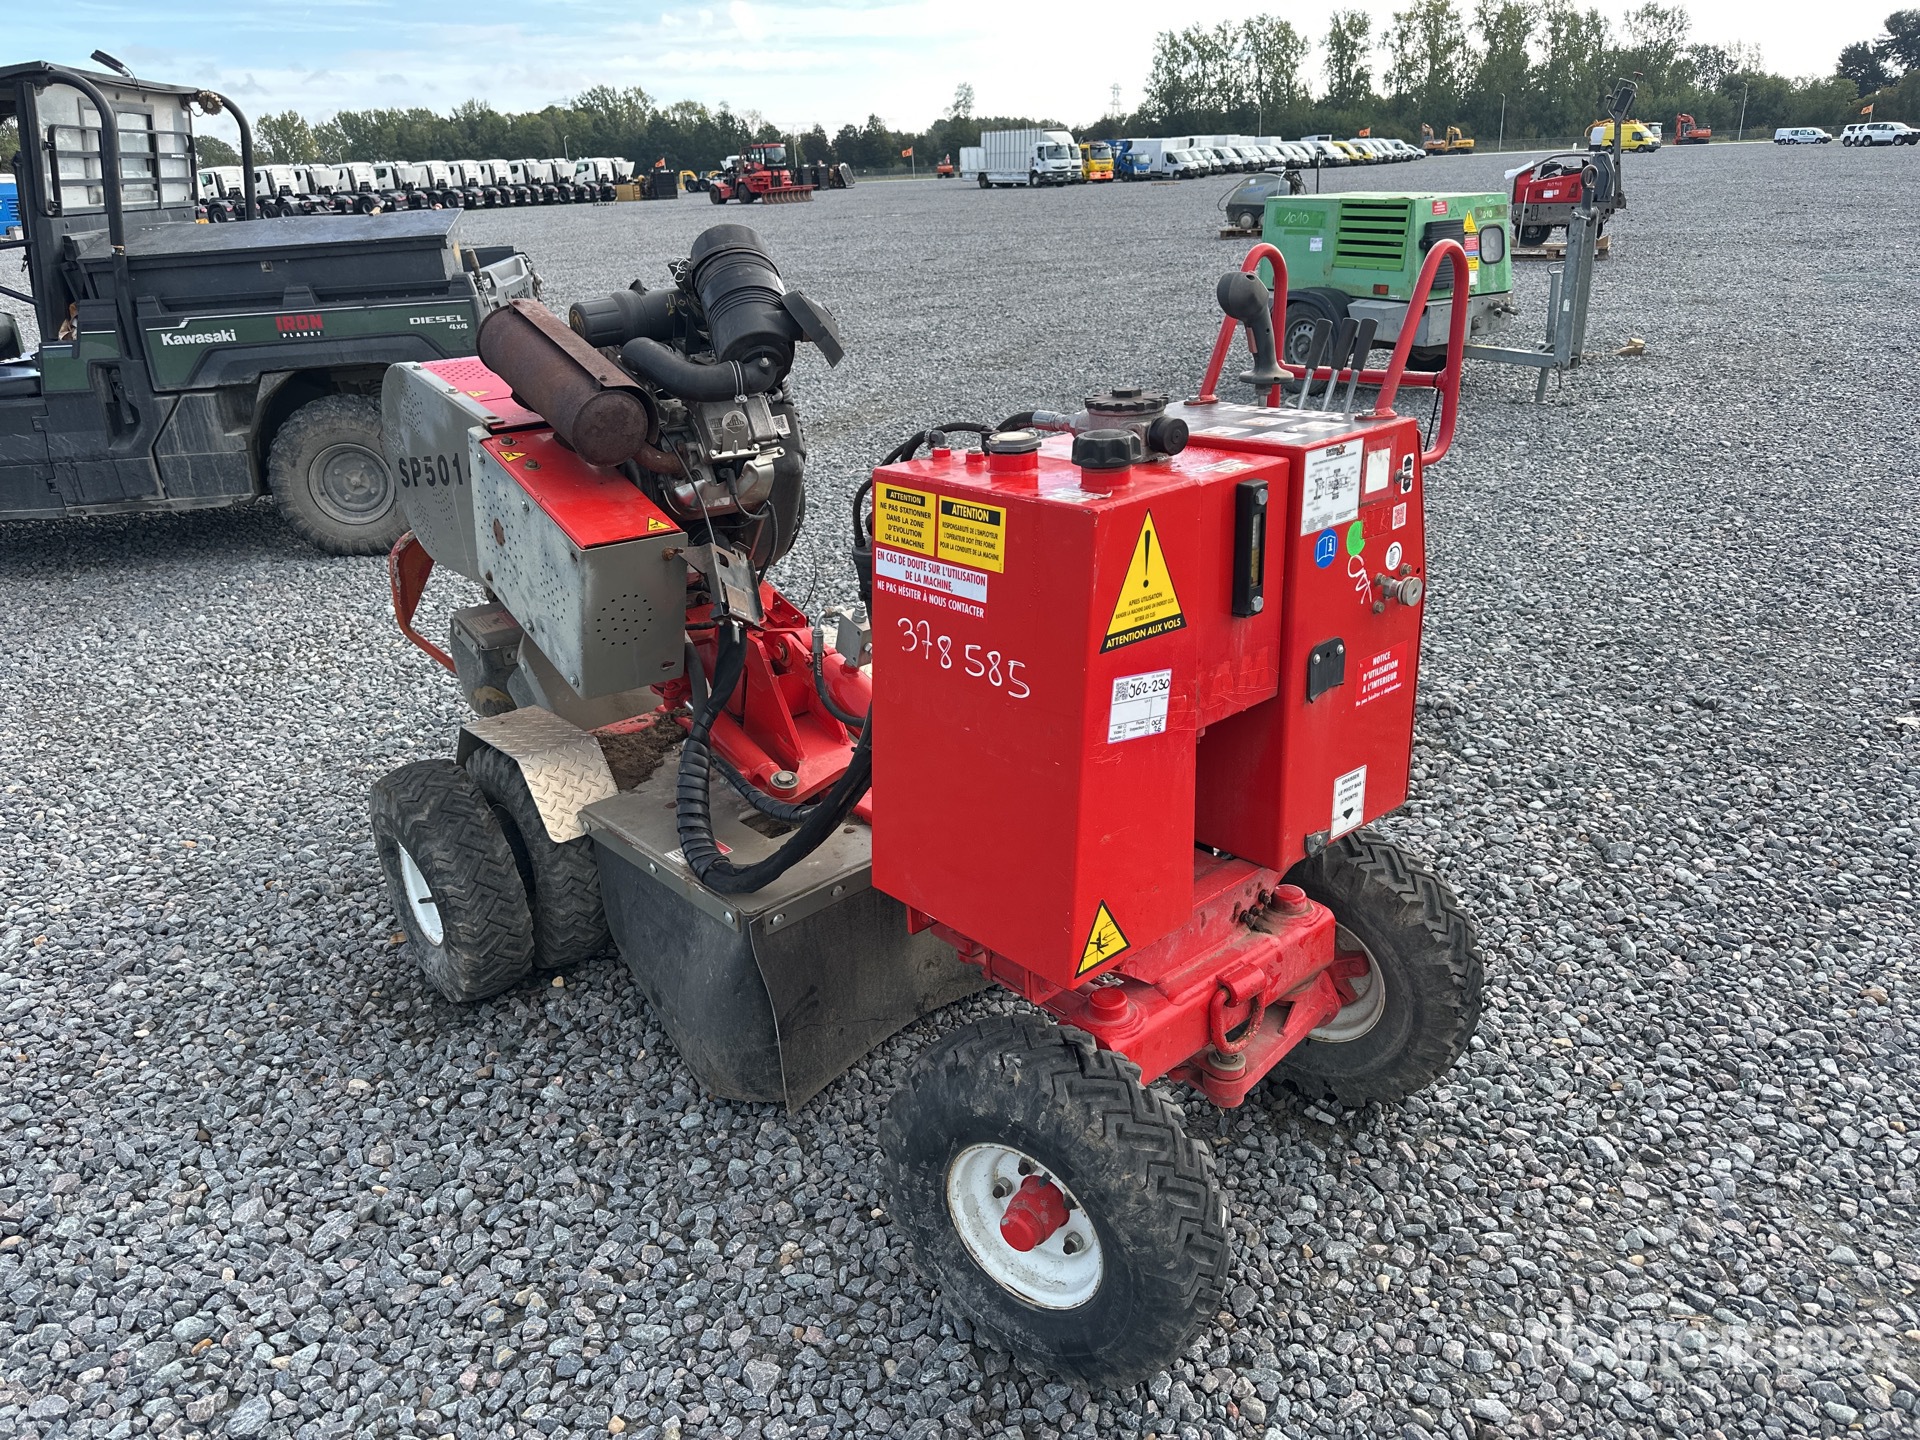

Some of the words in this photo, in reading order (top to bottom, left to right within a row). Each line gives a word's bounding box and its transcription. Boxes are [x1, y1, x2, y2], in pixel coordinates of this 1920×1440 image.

[1284, 211, 1310, 225] 1010
[275, 314, 324, 331] IRON
[409, 314, 468, 325] DIESEL
[448, 322, 469, 330] 4x4
[161, 329, 237, 346] Kawasaki
[282, 331, 322, 339] PLANET
[398, 452, 471, 488] SP501
[890, 492, 921, 504] ATTENTION
[880, 501, 888, 510] NE
[888, 503, 898, 512] PAS
[899, 505, 932, 519] STATIONNER
[951, 503, 989, 522] ATTENTION
[886, 513, 901, 523] DANS
[901, 517, 909, 525] LA
[910, 519, 924, 529] ZONE
[888, 523, 922, 538] D'EVOLUTION
[885, 533, 892, 541] DE
[893, 535, 900, 543] LA
[900, 537, 925, 550] MACHINE
[966, 536, 975, 544] DOIT
[940, 541, 950, 550] POUR
[955, 544, 972, 555] CONDUITE
[972, 547, 977, 555] DE
[977, 549, 982, 557] LA
[982, 550, 999, 561] MACHINE
[877, 549, 885, 561] EN
[885, 552, 897, 564] CAS
[898, 555, 907, 566] DE
[907, 557, 927, 572] DOUTE
[928, 563, 941, 575] SUR
[942, 566, 986, 587] L'UTILISATION
[905, 570, 914, 581] DE
[914, 572, 922, 583] LA
[923, 574, 953, 593] MACHINE,
[877, 579, 885, 591] NE
[885, 581, 897, 593] PAS
[897, 583, 922, 600] HÉSITER
[922, 588, 928, 602] À
[928, 593, 947, 608] NOUS
[947, 598, 985, 618] CONTACTER
[1106, 628, 1147, 649] ATTENTION
[1147, 622, 1163, 636] AUX
[1163, 617, 1181, 630] VOLS
[898, 617, 952, 669] 378
[964, 644, 1031, 699] 585
[1372, 651, 1391, 666] NOTICE
[1362, 659, 1399, 682] D'UTILISATION
[1362, 685, 1367, 694] A
[1367, 671, 1398, 691] L'INTERIEUR
